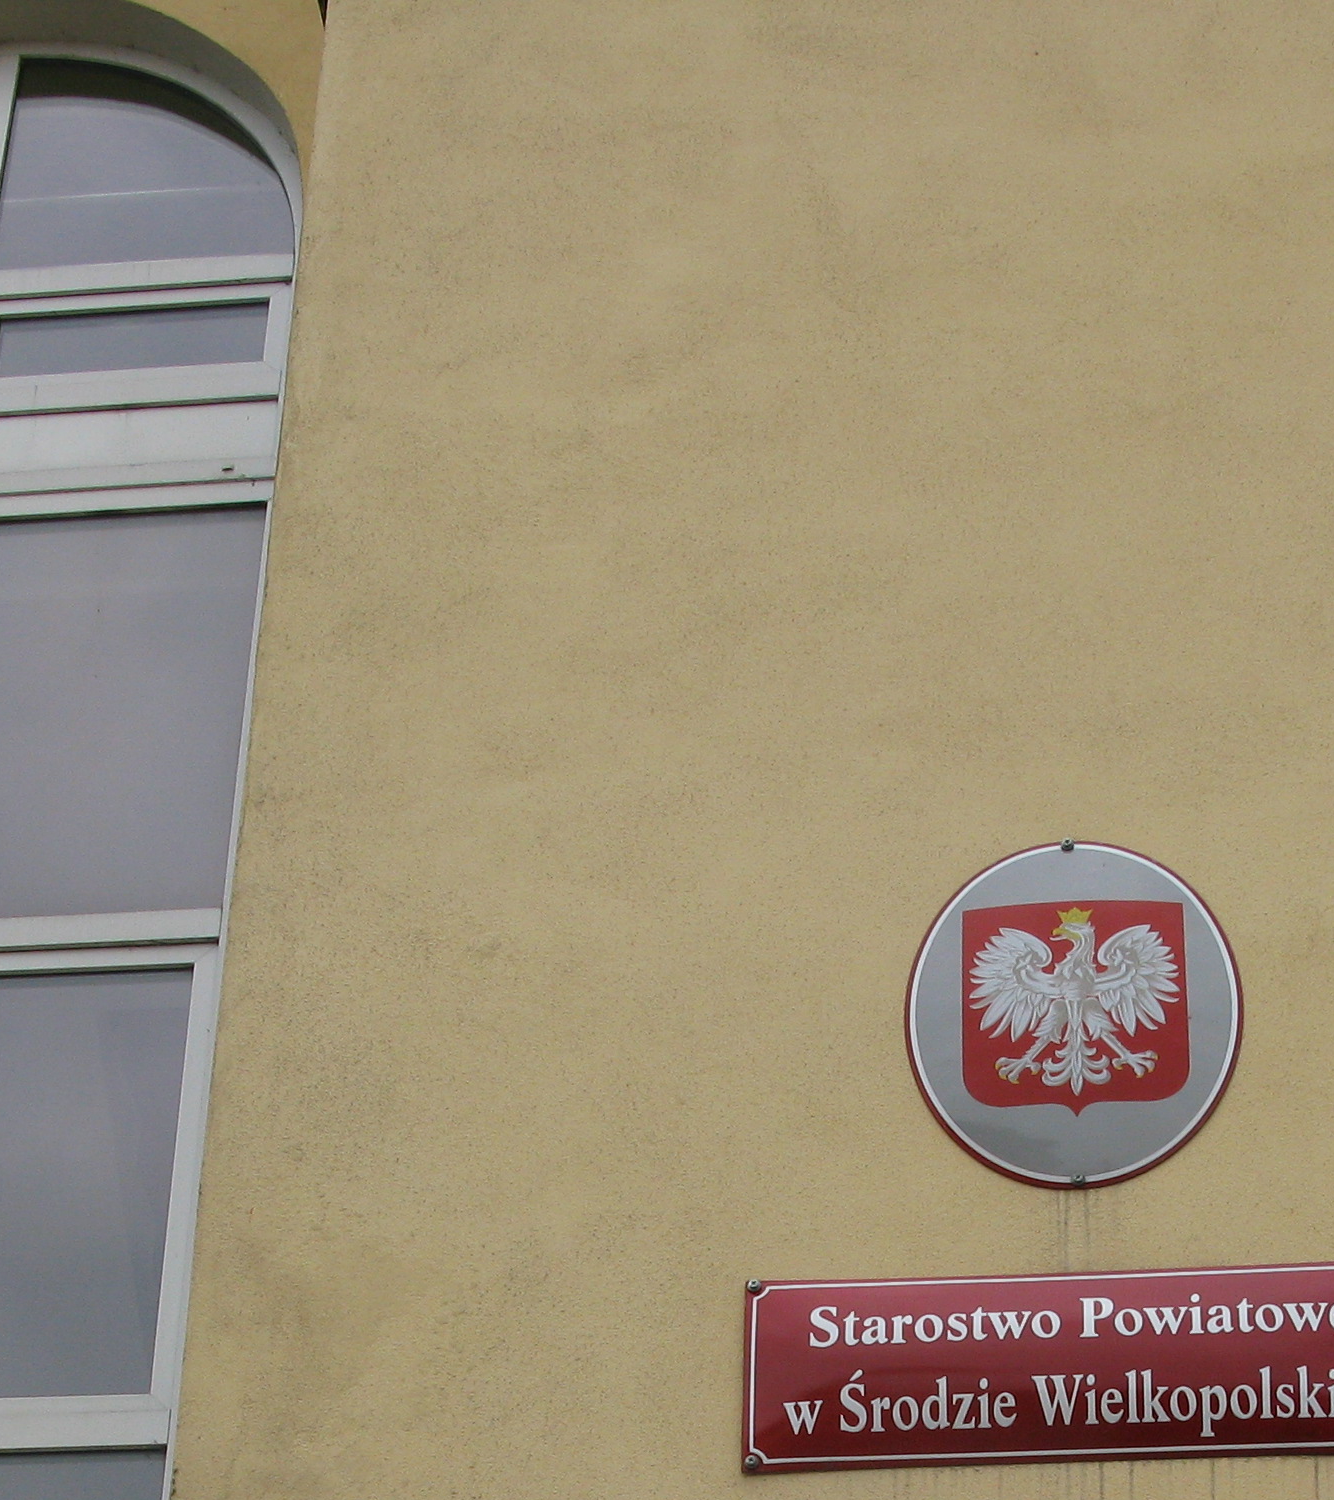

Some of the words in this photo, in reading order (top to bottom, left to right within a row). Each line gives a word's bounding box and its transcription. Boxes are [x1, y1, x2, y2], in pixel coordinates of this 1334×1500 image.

[808, 1305, 1060, 1348] Starostwo
[784, 1400, 822, 1435] w
[839, 1370, 1016, 1433] Środzie
